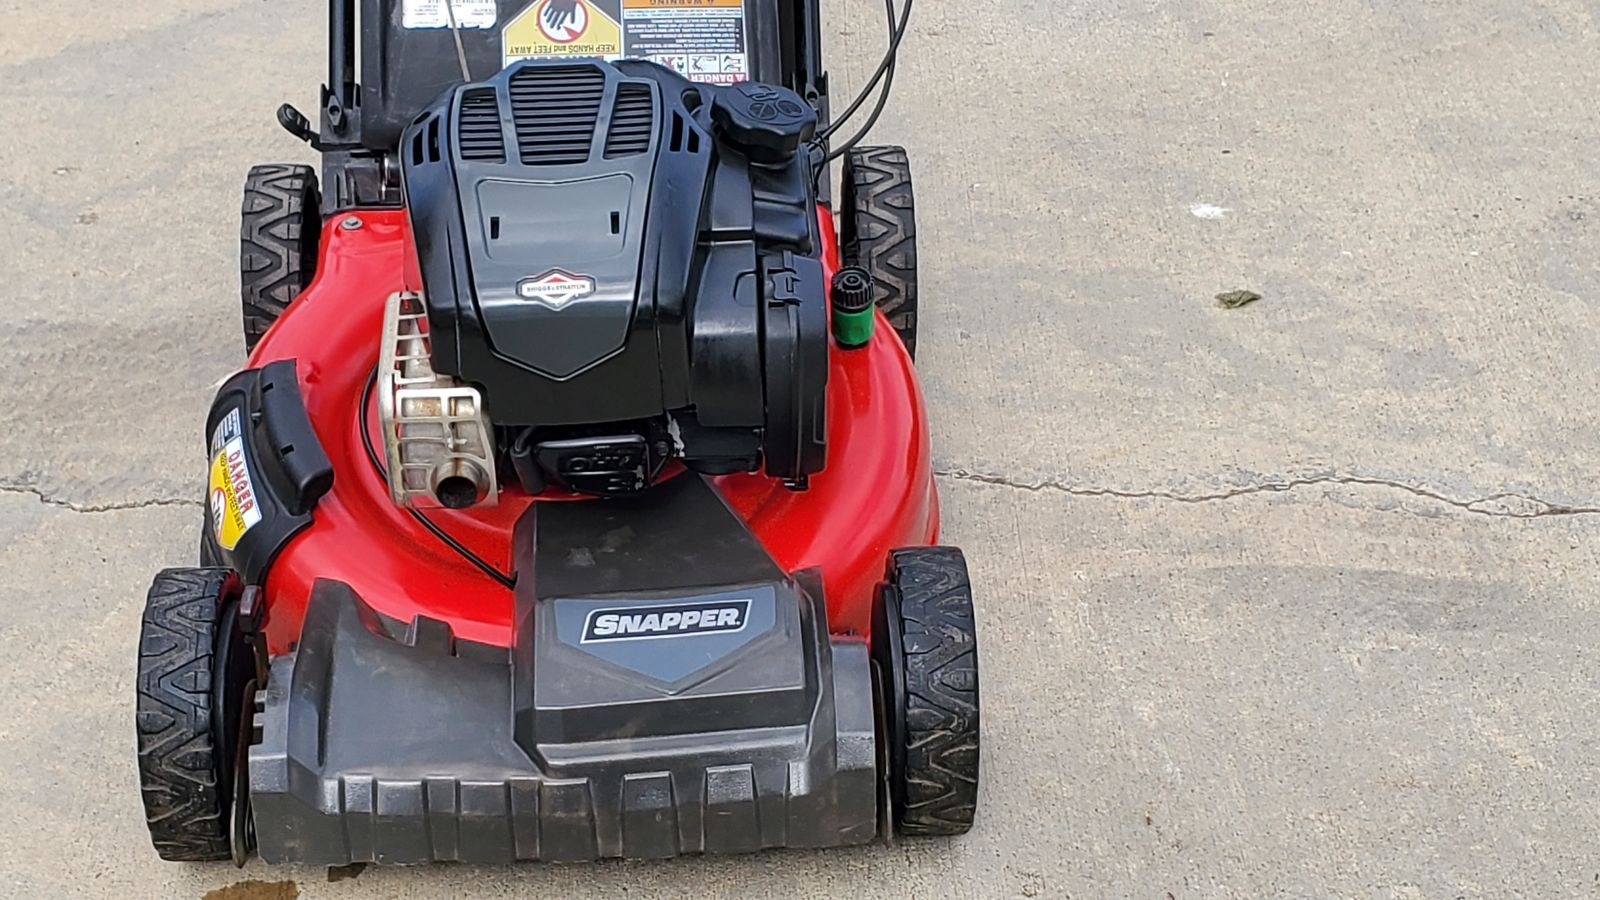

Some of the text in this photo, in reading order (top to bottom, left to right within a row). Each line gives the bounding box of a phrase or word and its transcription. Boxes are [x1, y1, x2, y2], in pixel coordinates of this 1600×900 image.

[509, 46, 531, 54] AWAY
[533, 45, 552, 53] FEET
[568, 44, 594, 52] HANDS
[596, 44, 615, 52] KEEP
[691, 74, 734, 82] DANGER
[228, 449, 254, 515] DANGER
